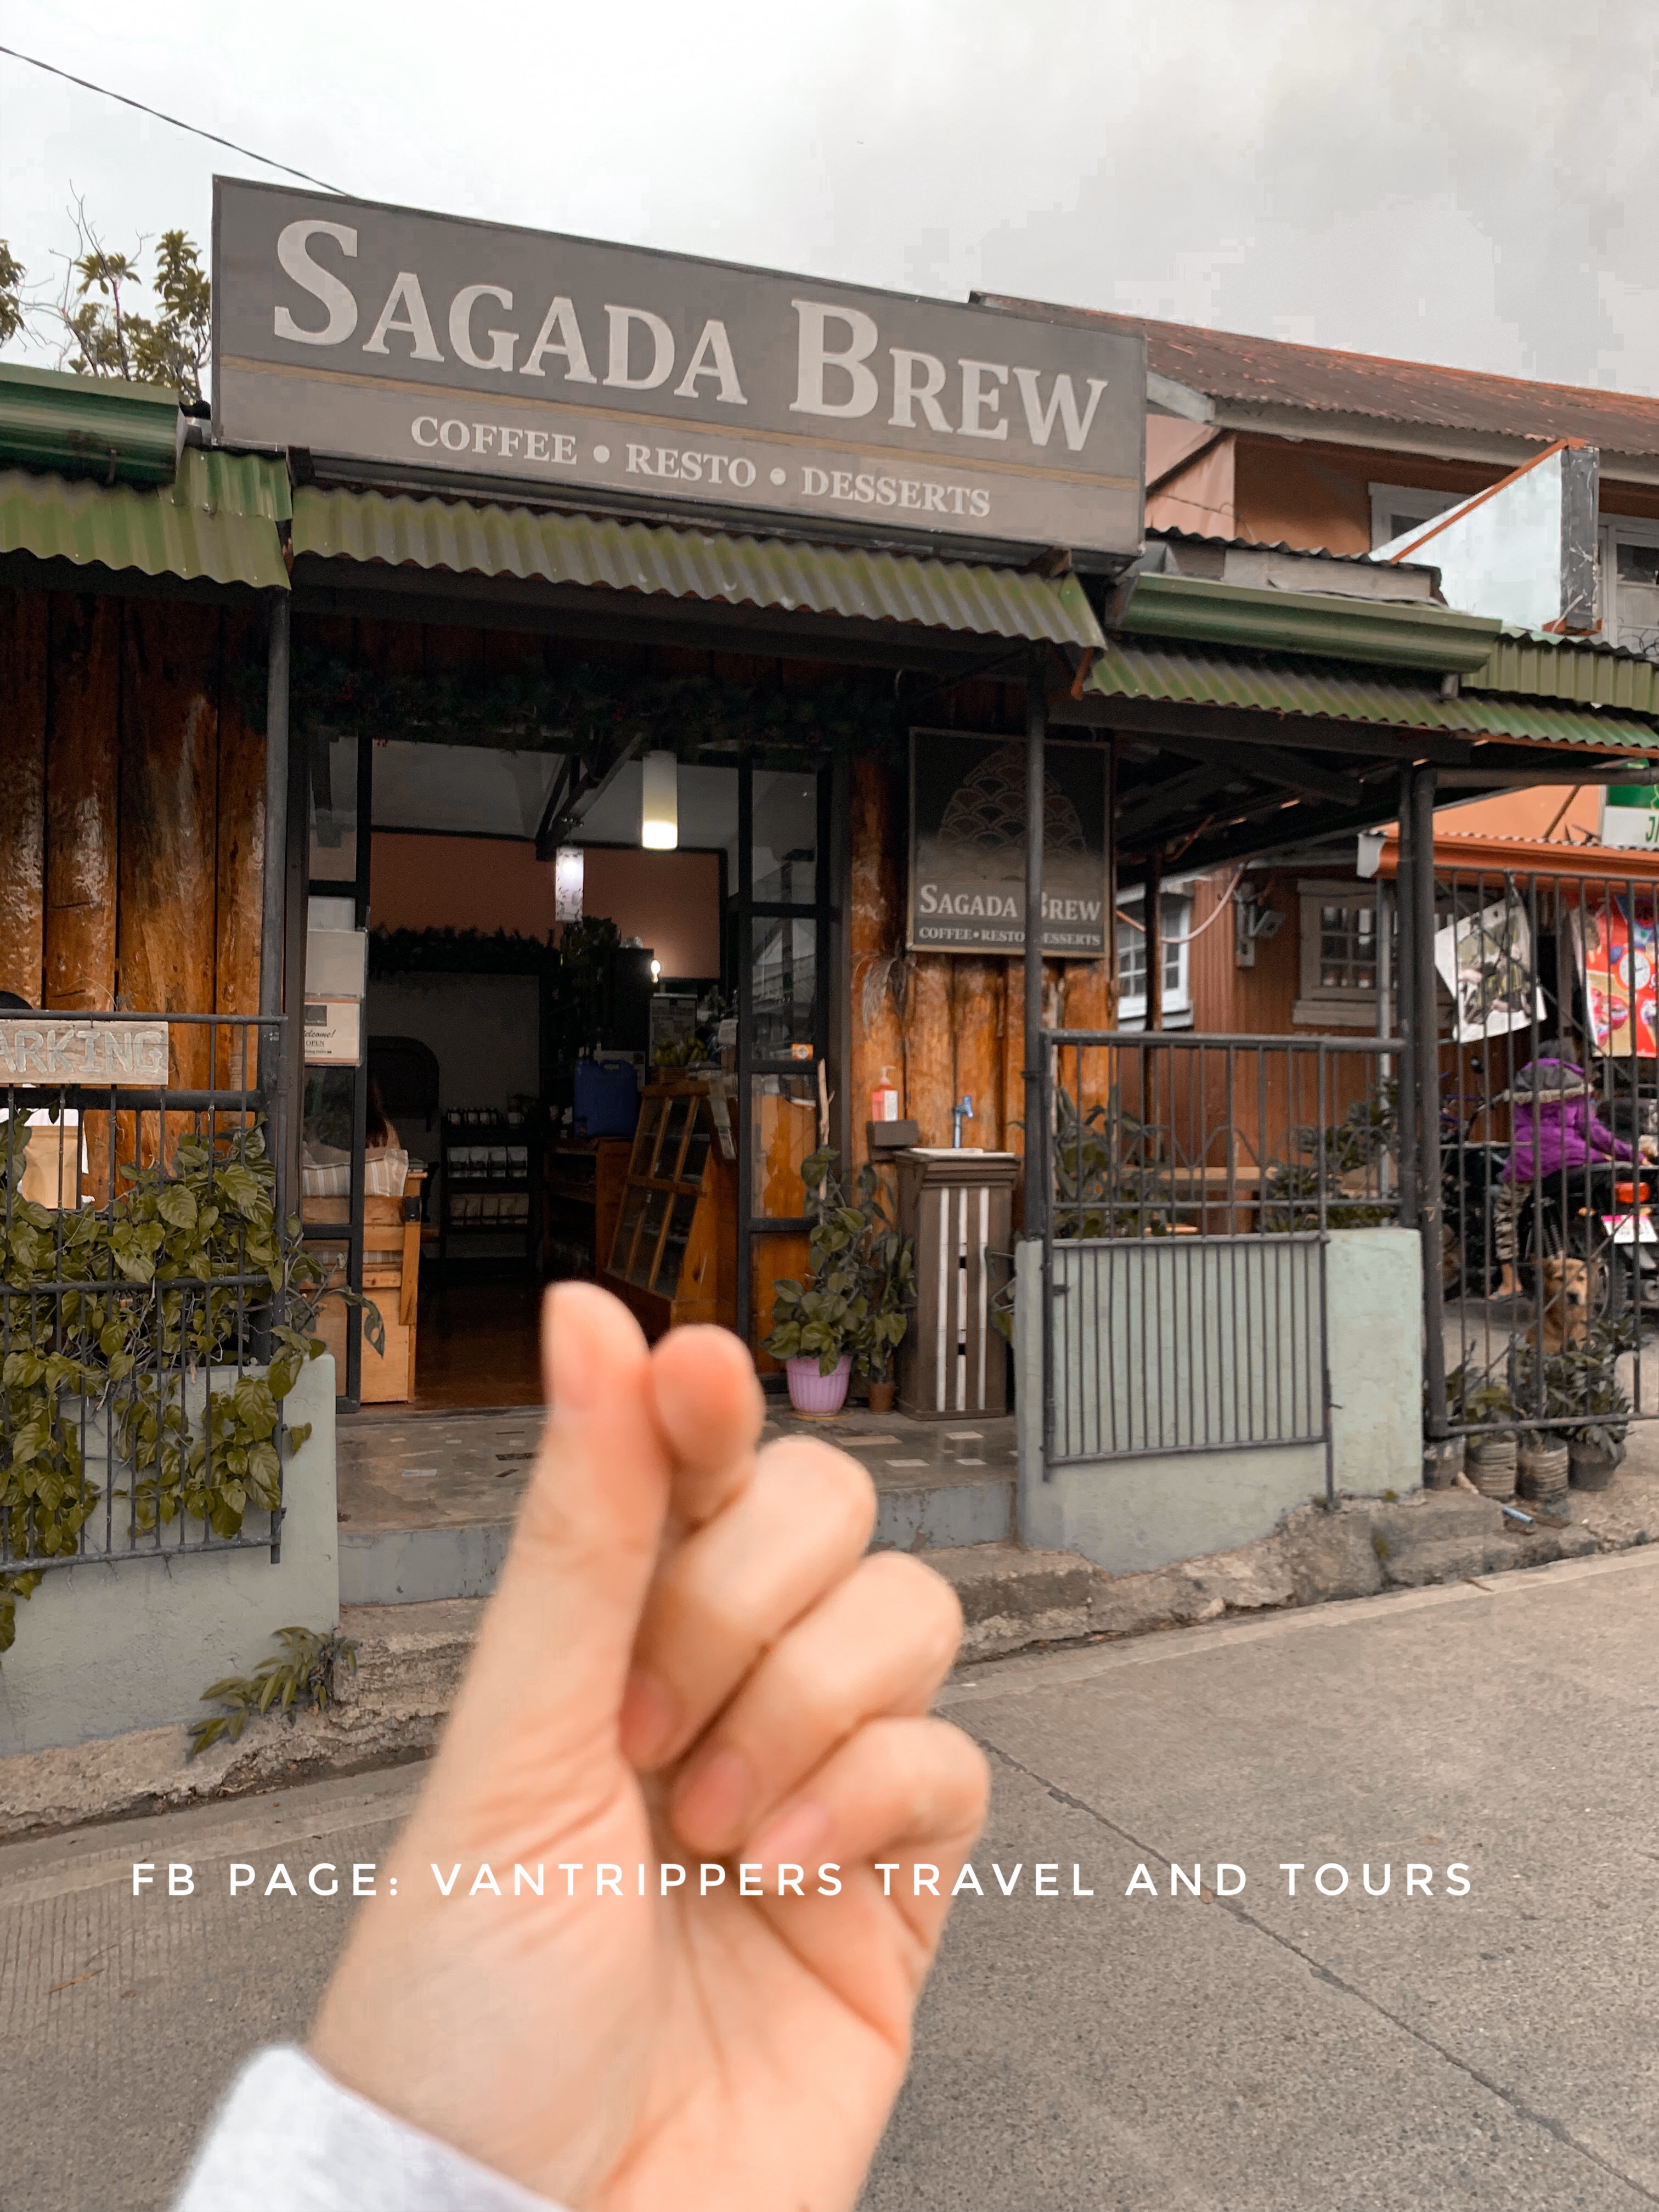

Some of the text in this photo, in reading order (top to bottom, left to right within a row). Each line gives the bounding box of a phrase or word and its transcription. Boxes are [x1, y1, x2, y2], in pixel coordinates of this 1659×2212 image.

[274, 219, 1109, 452] SAGADA BREW
[411, 415, 991, 518] COFFEE RESTO DESSERTS
[919, 884, 1018, 918] SAGADA
[918, 927, 1101, 946] COFFEE RESTO ESSERTS
[304, 1029, 336, 1038] elcome!
